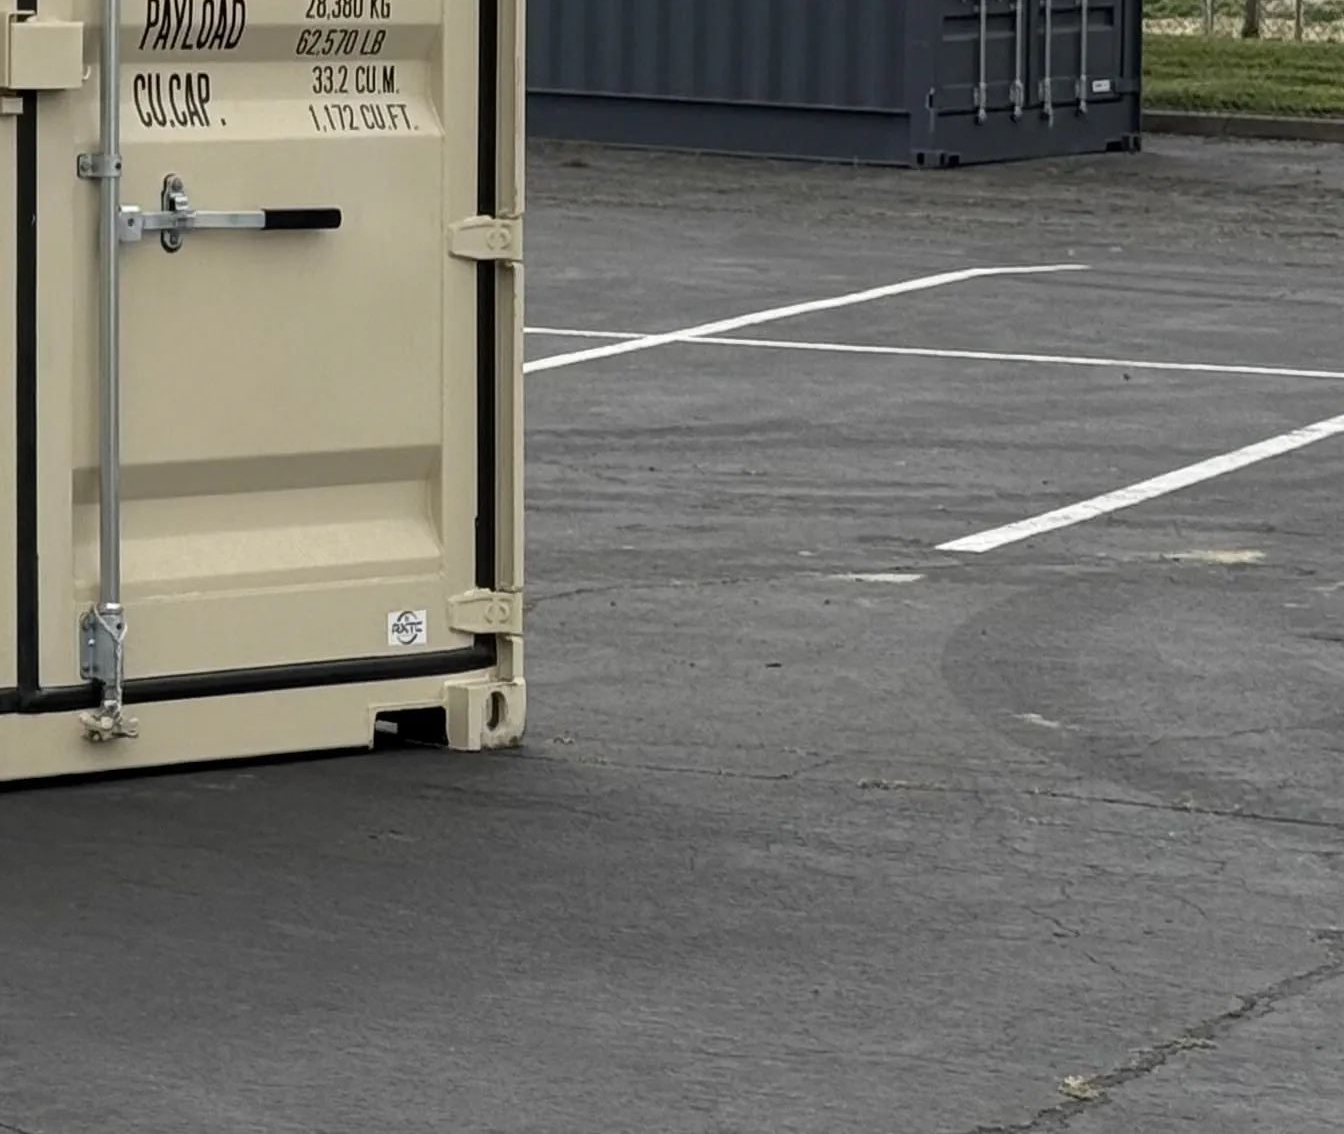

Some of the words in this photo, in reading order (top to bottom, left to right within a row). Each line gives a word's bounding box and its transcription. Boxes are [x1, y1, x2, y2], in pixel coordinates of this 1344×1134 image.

[295, 29, 359, 56] 62,570
[359, 30, 387, 56] LB
[312, 66, 349, 94] 33.2
[355, 67, 400, 95] CU.M.
[308, 104, 360, 133] 1,172
